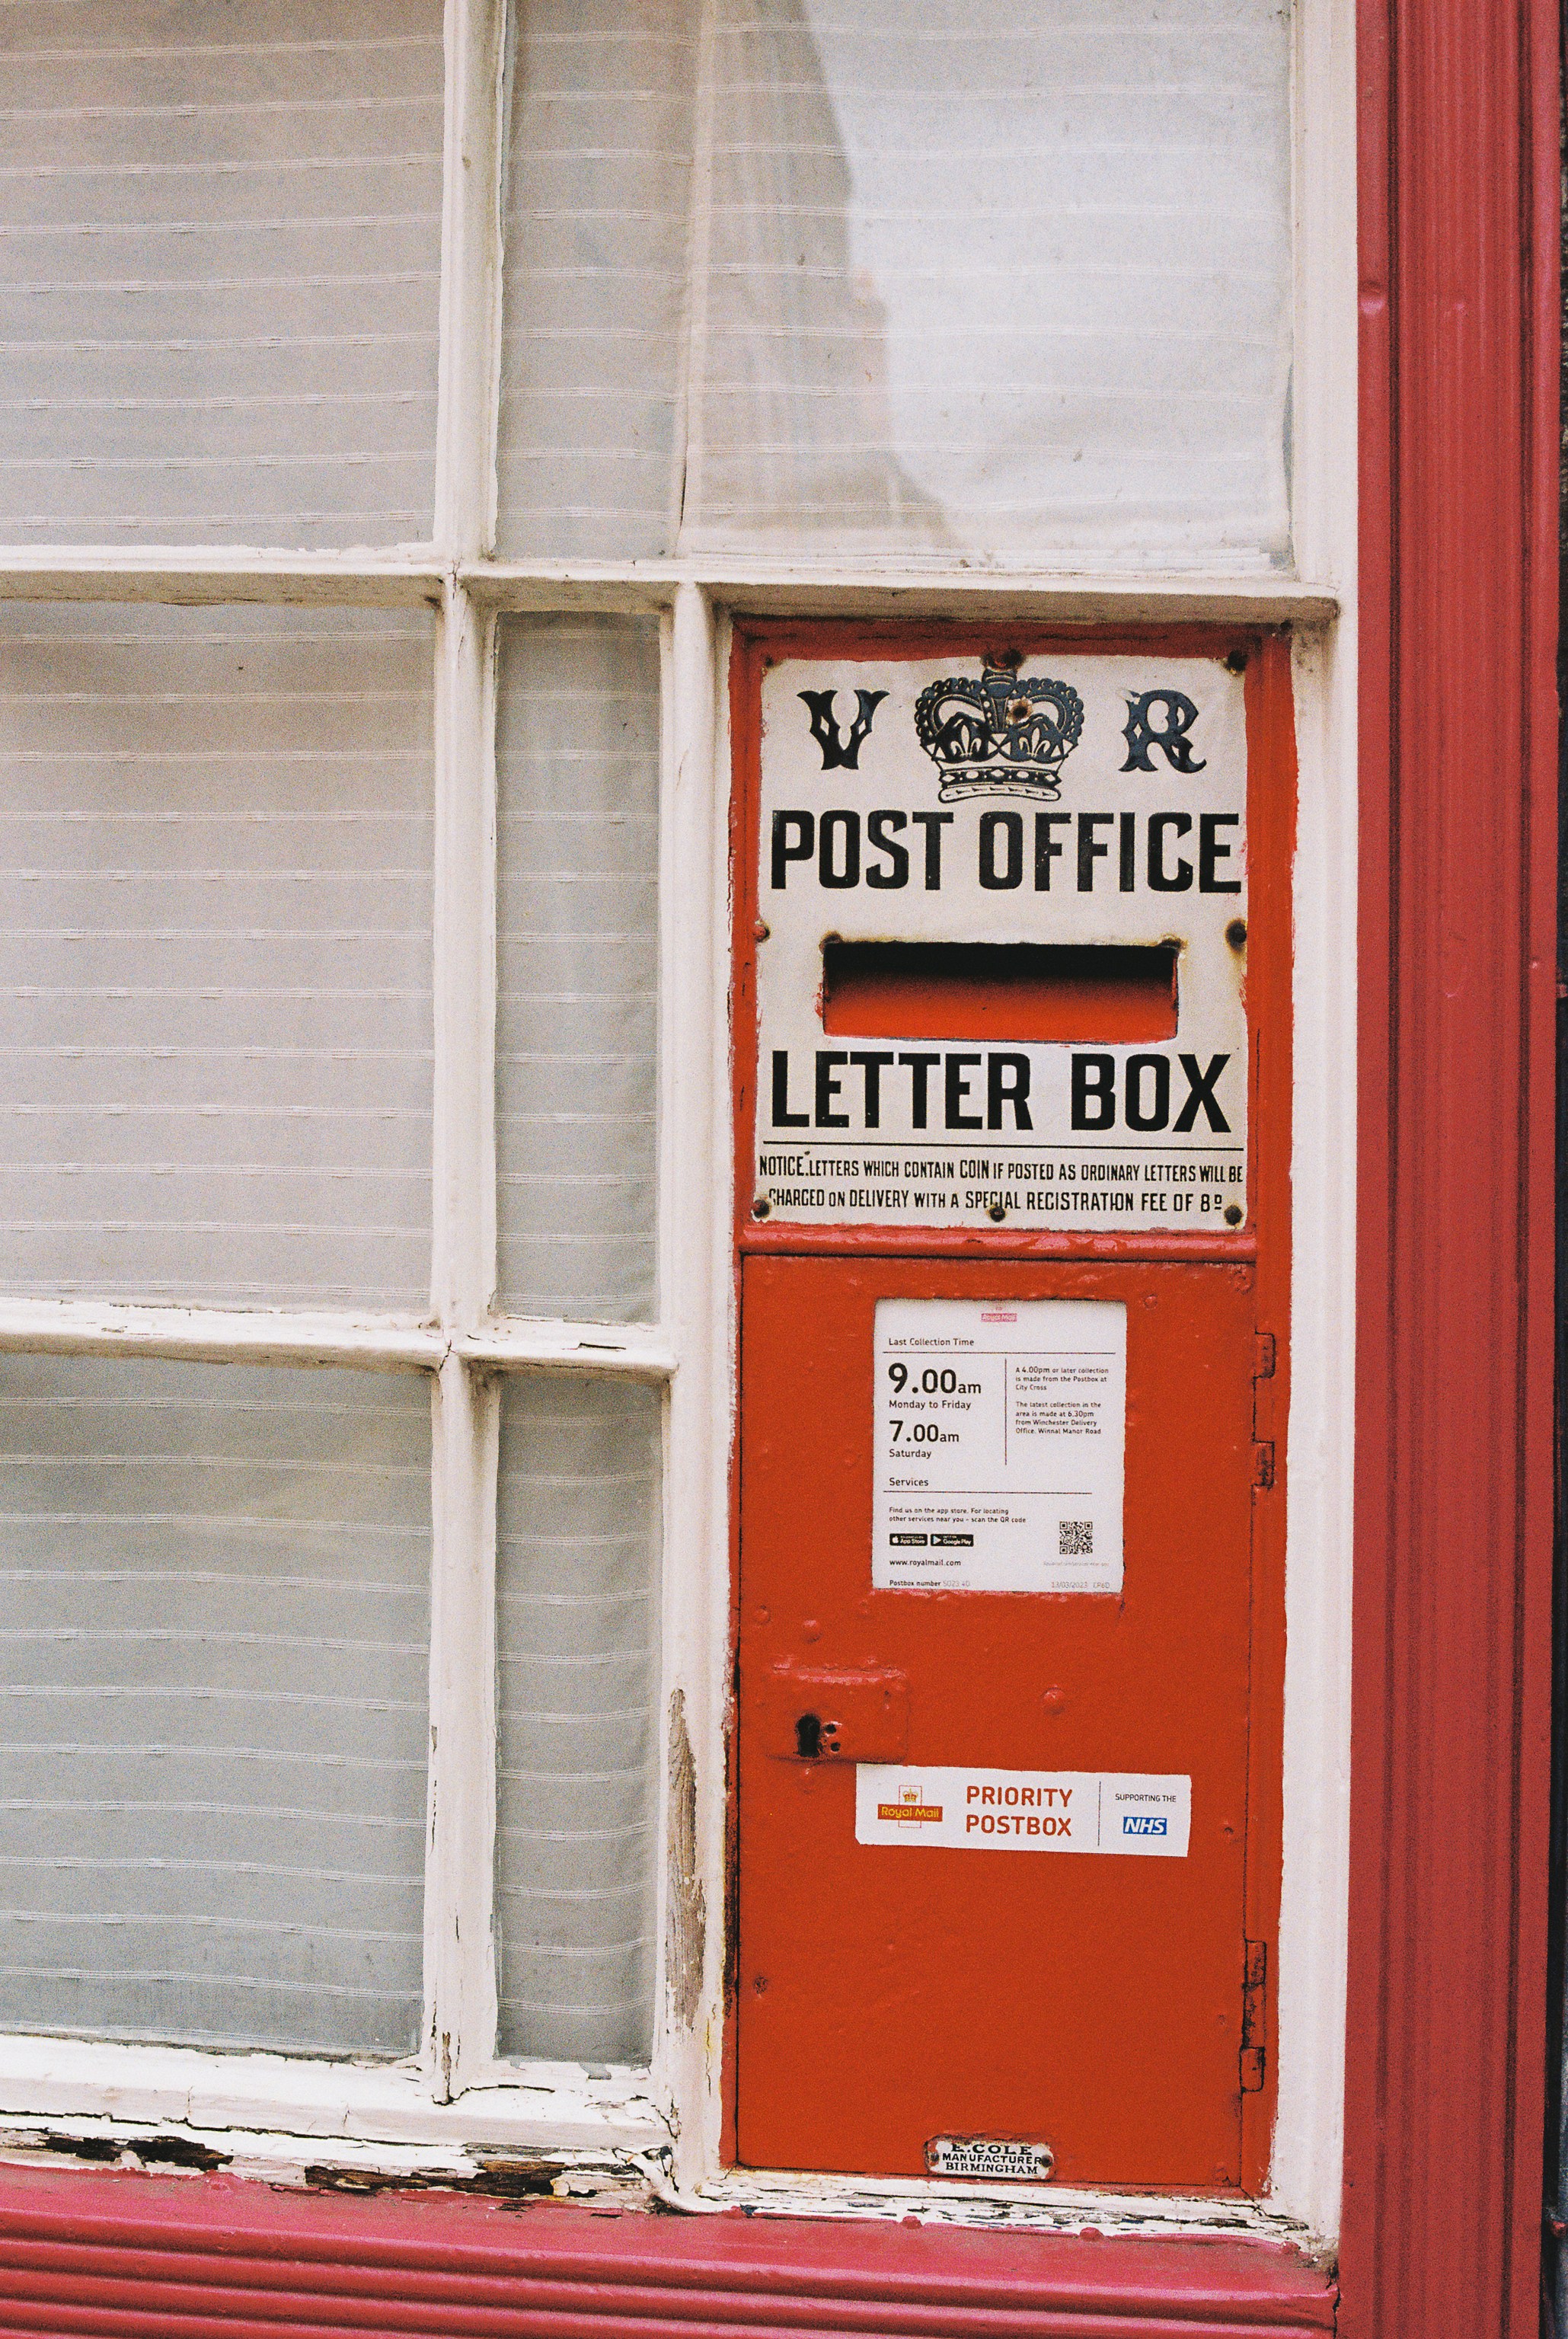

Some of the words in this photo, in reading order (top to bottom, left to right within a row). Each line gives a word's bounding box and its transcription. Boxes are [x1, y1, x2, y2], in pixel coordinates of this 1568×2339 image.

[797, 689, 889, 770] V
[1118, 689, 1207, 773] R
[771, 810, 953, 890] POST
[979, 811, 1241, 893] OFFICE
[771, 1050, 1033, 1130] LETTER
[1071, 1053, 1231, 1133] BOX
[810, 1160, 859, 1177] LETTERS
[864, 1160, 899, 1177] WHICH
[905, 1161, 954, 1178] CONTAIN
[960, 1159, 989, 1179] COIN
[993, 1162, 1004, 1179] IF
[1008, 1162, 1054, 1181] POSTED
[1059, 1164, 1077, 1181] AS
[1081, 1164, 1140, 1181] ORDINARY
[1144, 1165, 1196, 1182] LETTERS
[1199, 1165, 1226, 1183] WILL
[1228, 1165, 1244, 1183] BE
[768, 1188, 825, 1206] CHARGED
[829, 1191, 845, 1207] ON
[849, 1189, 909, 1208] DELIVERY
[914, 1192, 946, 1208] WITH
[951, 1193, 960, 1208] A
[965, 1190, 1021, 1209] SPECIAL
[1027, 1191, 1134, 1211] REGISTRATION
[1142, 1193, 1167, 1212] FEE
[1174, 1193, 1194, 1212] OF
[889, 1337, 907, 1346] Last
[909, 1337, 950, 1346] Collection
[1022, 1366, 1050, 1374] 4.00pm
[888, 1363, 982, 1394] 9.00am
[889, 1400, 925, 1411] Monday
[942, 1400, 972, 1411] Friday
[889, 1420, 960, 1443] 7.00am
[889, 1449, 932, 1459] Saturday
[889, 1477, 929, 1487] Services
[966, 1785, 1073, 1807] PRIORITY
[1116, 1794, 1161, 1802] SUPPORTING
[881, 1807, 912, 1818] Royal
[915, 1807, 939, 1818] Mail
[966, 1814, 1071, 1836] POSTBOX
[1124, 1818, 1165, 1834] NHS
[942, 2153, 1043, 2165] MANUFACTURER
[946, 2162, 1038, 2174] BIRMINGHAM
